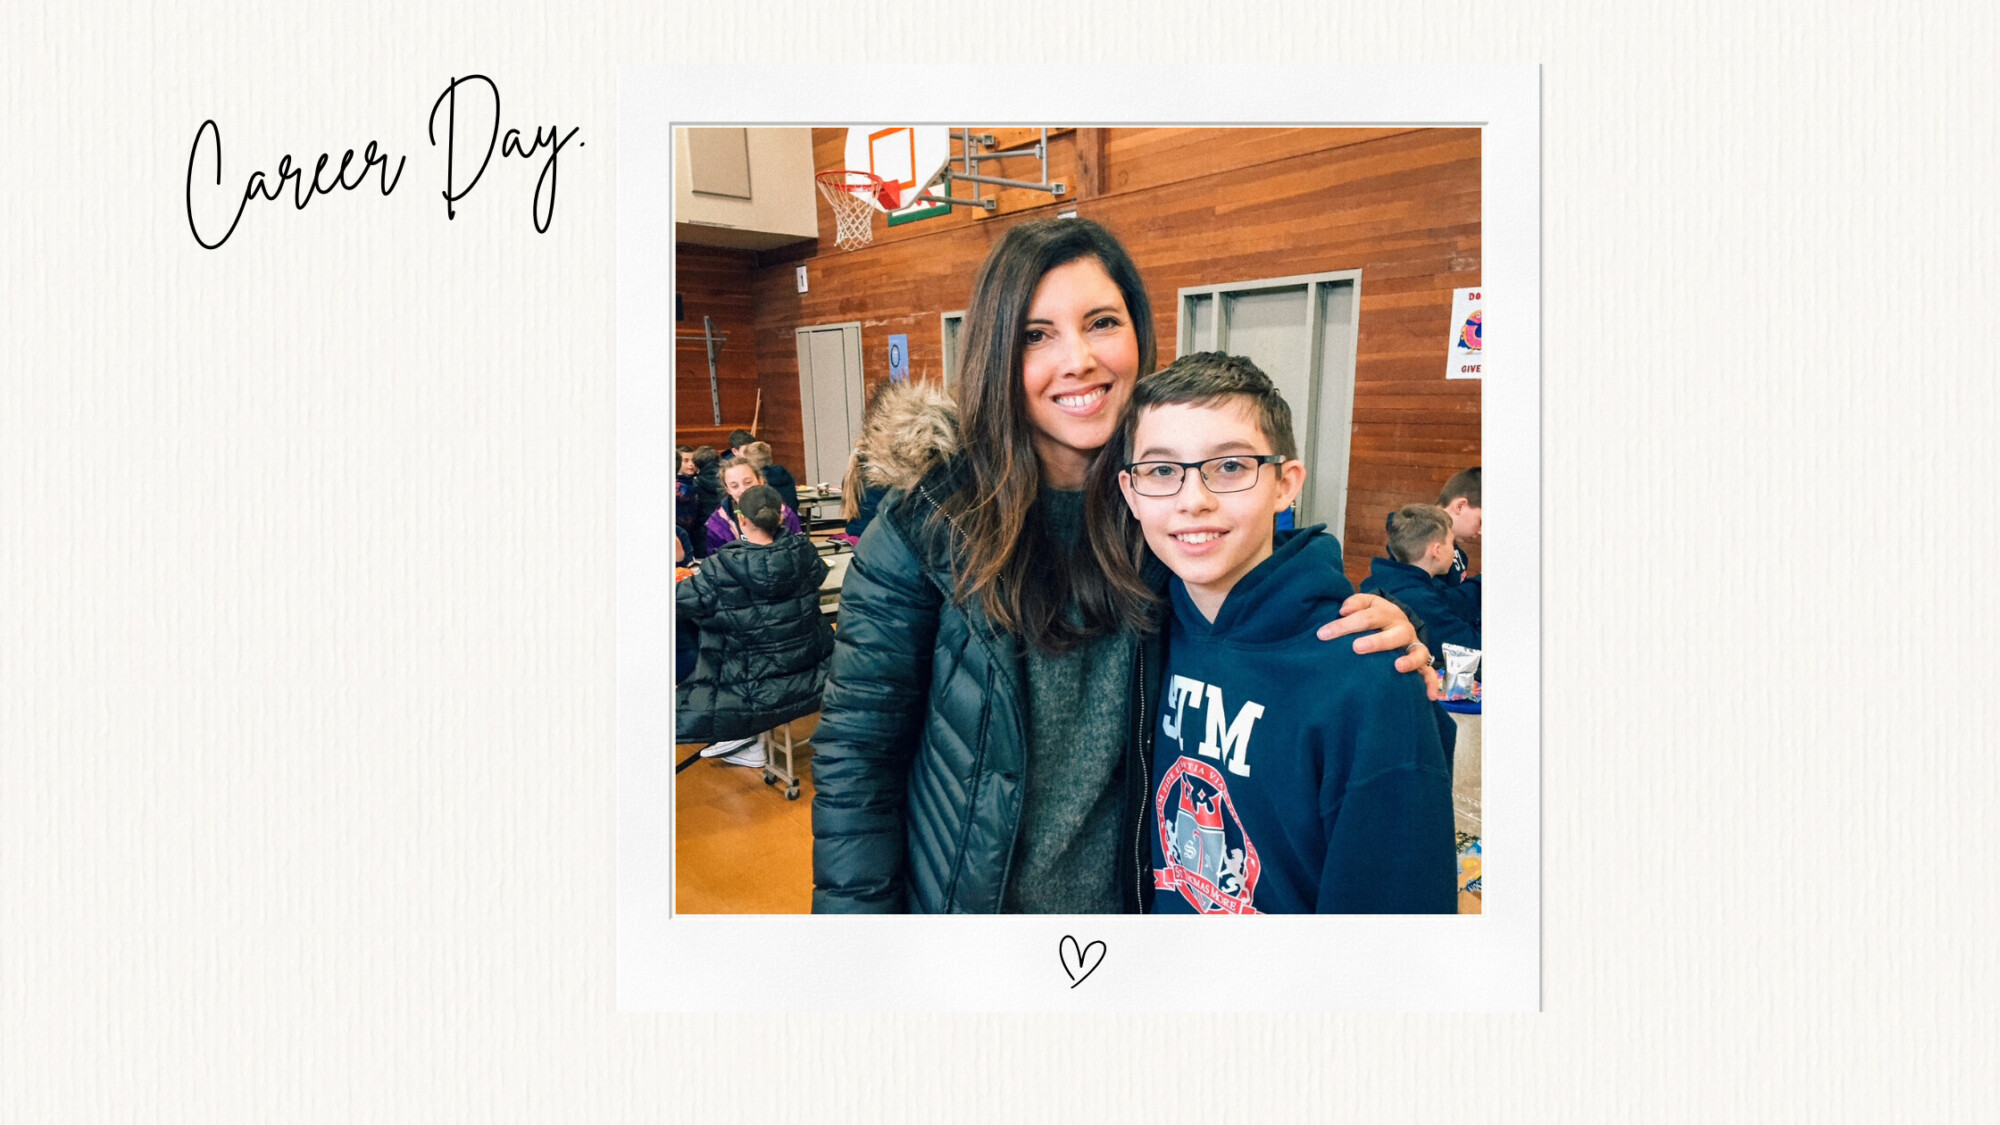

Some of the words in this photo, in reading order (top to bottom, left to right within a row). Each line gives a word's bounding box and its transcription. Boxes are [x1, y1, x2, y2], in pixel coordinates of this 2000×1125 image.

[1460, 364, 1482, 374] GIVE
[1162, 674, 1266, 778] STM
[1209, 885, 1238, 912] MORE
